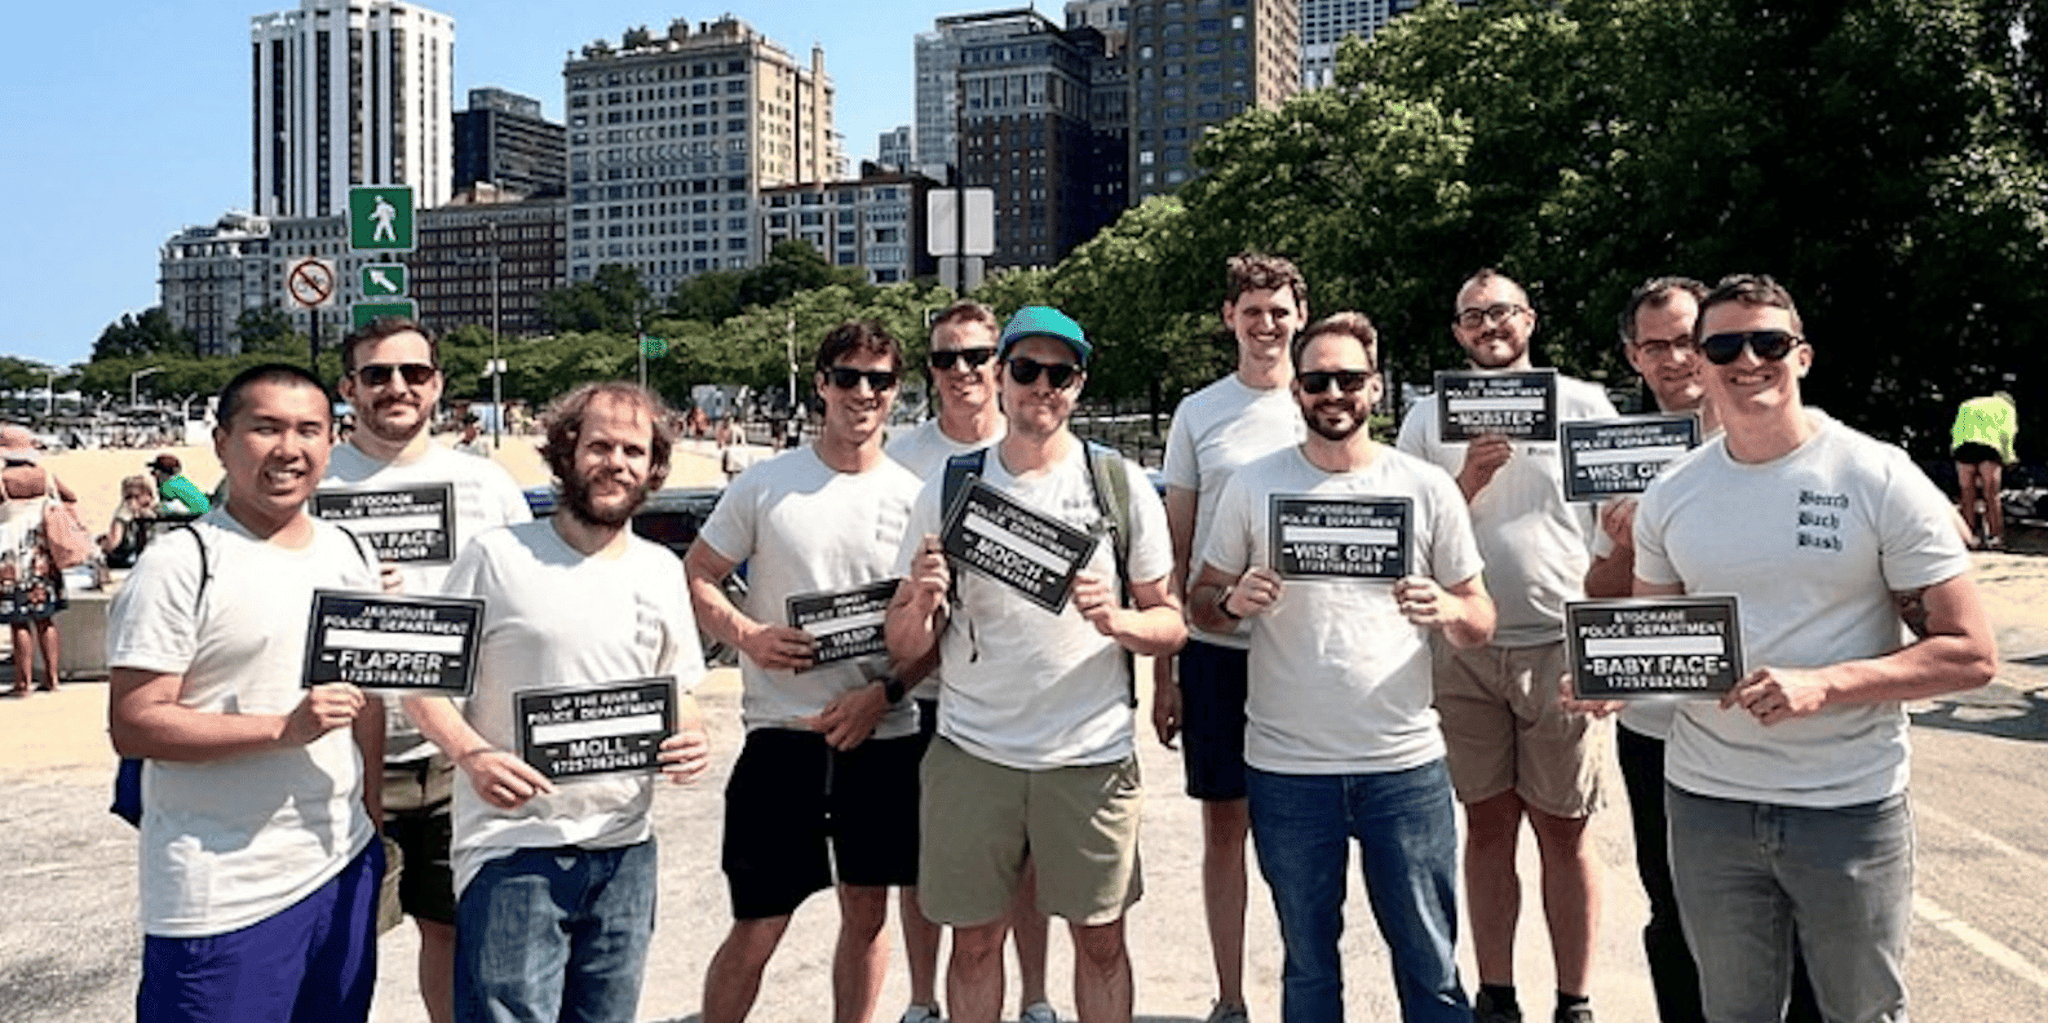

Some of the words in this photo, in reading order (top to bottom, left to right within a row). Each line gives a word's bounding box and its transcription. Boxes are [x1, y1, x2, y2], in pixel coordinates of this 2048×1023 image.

[1570, 438, 1611, 450] POLICE
[1614, 433, 1691, 448] DEPARTMENT
[320, 507, 366, 519] POLICE
[368, 502, 444, 516] DEPARTMENT
[1279, 514, 1321, 525] POLICE
[1325, 515, 1400, 527] DEPARTMENT
[968, 500, 1006, 526] POLICE
[1008, 521, 1079, 559] DEPARTMENT
[362, 605, 438, 621] JAILHOUSE
[798, 608, 835, 623] POLICE
[1613, 609, 1685, 624] STOCKADE
[323, 614, 374, 629] POLICE
[378, 618, 469, 635] DEPARTMENT
[1579, 623, 1629, 638] POLICE
[1632, 620, 1725, 636] DEPARTMENT
[551, 696, 573, 711] UP
[574, 693, 599, 709] THE
[600, 690, 640, 705] RIVER
[527, 709, 576, 726] POLICE
[579, 699, 666, 720] DEPARTMENT
